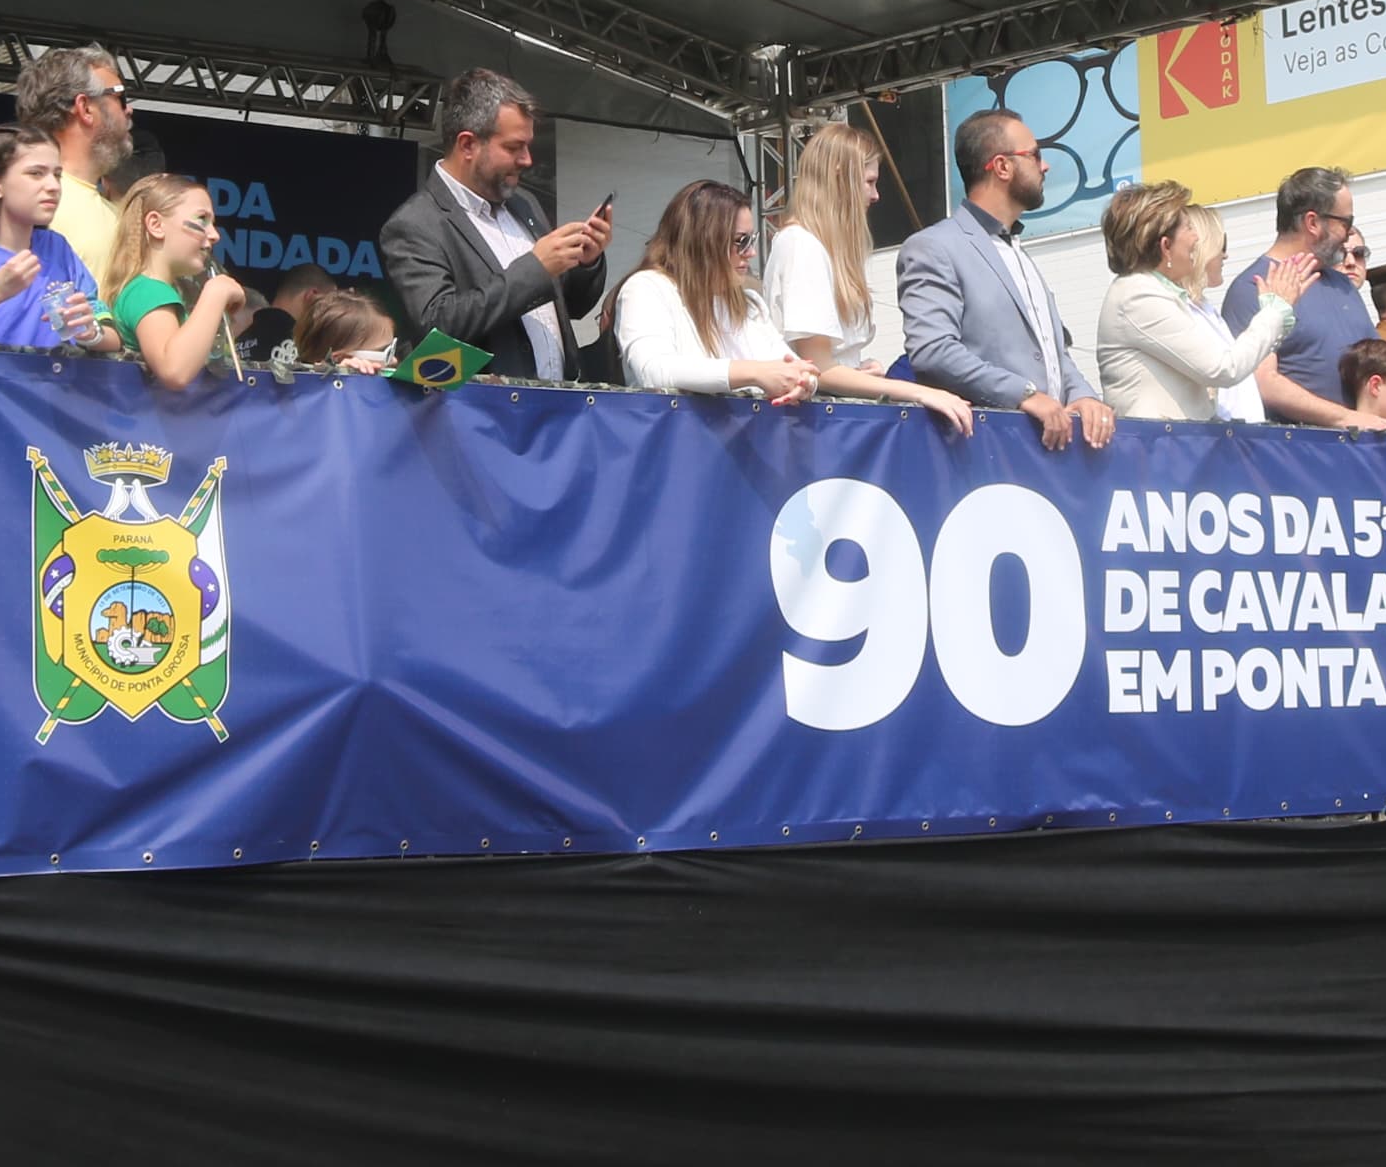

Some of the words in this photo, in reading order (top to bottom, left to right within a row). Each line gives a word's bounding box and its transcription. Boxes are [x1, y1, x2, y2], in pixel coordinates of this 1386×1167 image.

[1284, 46, 1327, 74] Veja
[1335, 42, 1358, 63] as
[1100, 489, 1262, 555] ANOS
[1270, 494, 1350, 557] DA
[769, 476, 1087, 732] 90
[1103, 568, 1181, 633] DE
[73, 633, 110, 685] MUNICÍPIO
[111, 679, 126, 692] DE
[128, 676, 164, 693] PONTA
[163, 634, 191, 678] GROSSA
[1105, 648, 1192, 713] EM
